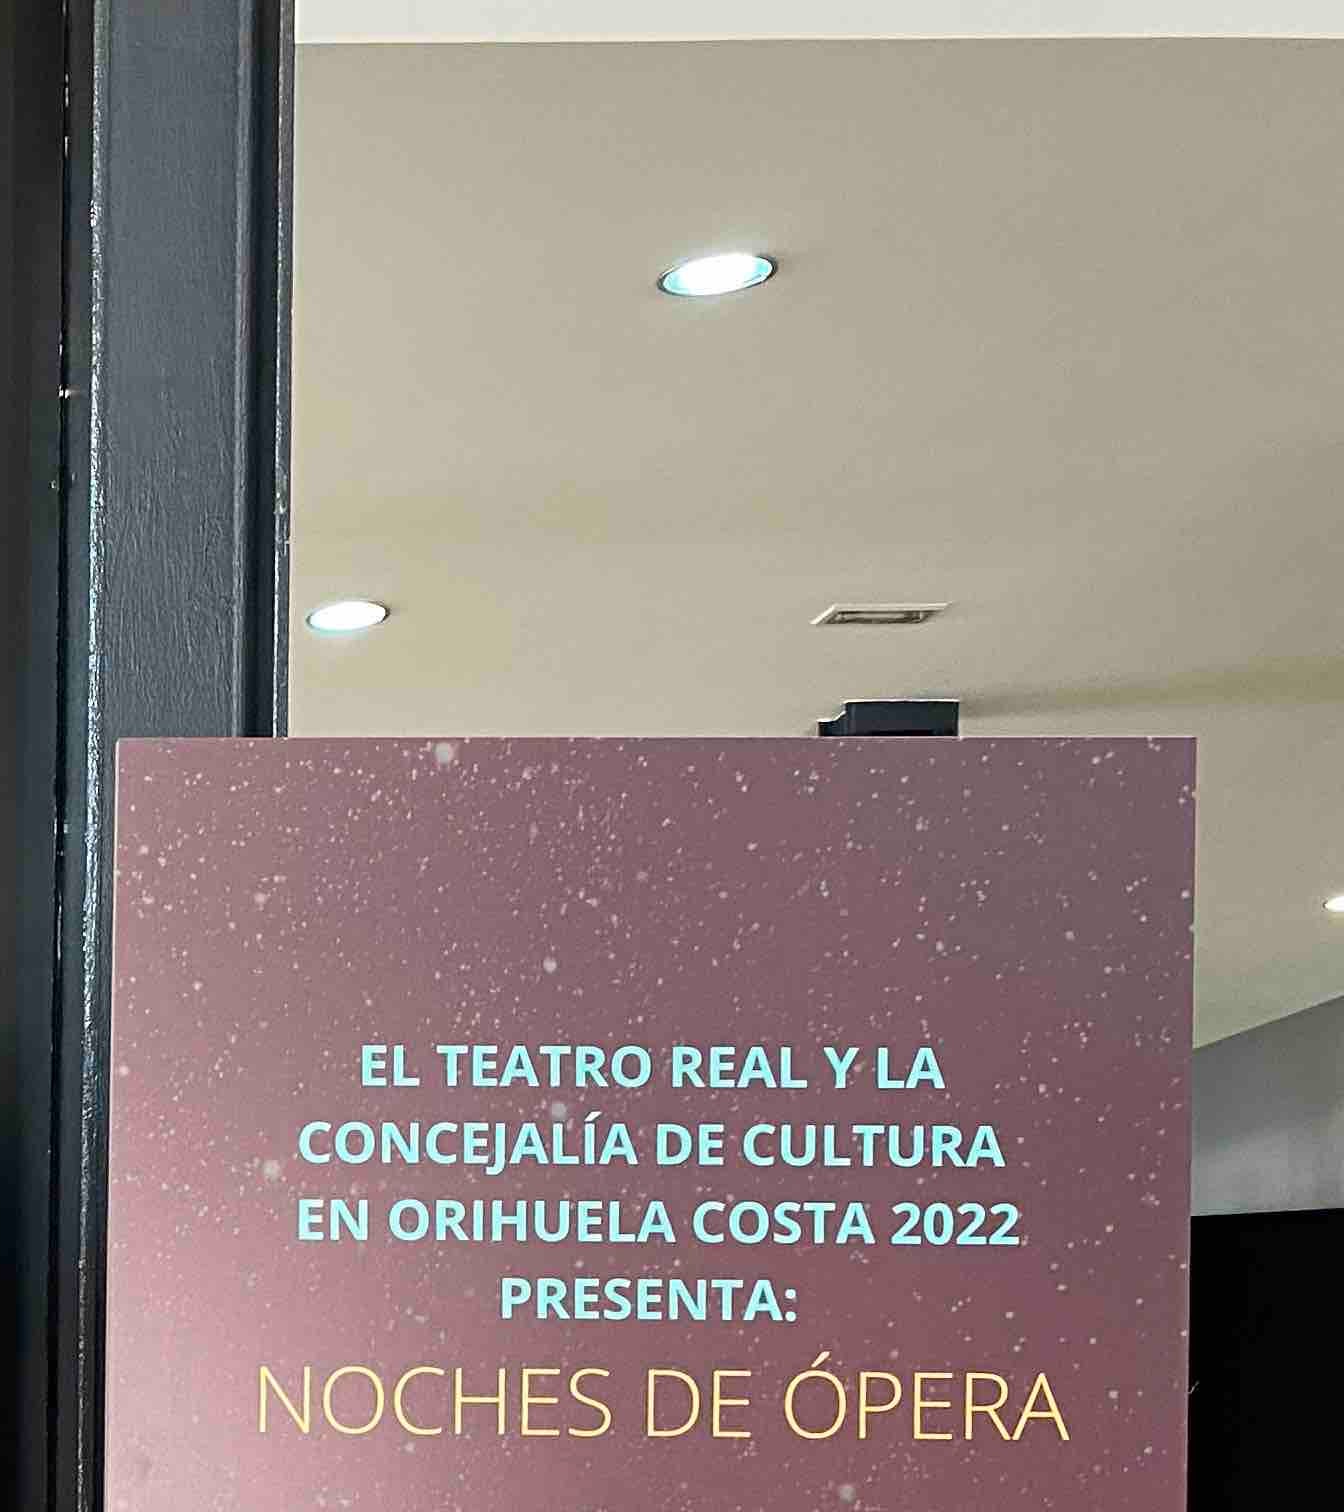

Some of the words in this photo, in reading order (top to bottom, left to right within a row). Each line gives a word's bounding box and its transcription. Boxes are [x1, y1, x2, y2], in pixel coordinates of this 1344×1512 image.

[360, 1044, 417, 1089] EL
[439, 1043, 653, 1089] TEATRO
[670, 1043, 807, 1090] REAL
[823, 1047, 857, 1090] Y
[875, 1046, 945, 1090] LA
[298, 1111, 637, 1176] CONCEJALÍA
[654, 1122, 722, 1168] DE
[742, 1122, 1006, 1169] CULTURA
[297, 1198, 370, 1242] EN
[387, 1198, 674, 1244] ORIHUELA
[692, 1199, 874, 1246] COSTA
[889, 1201, 1018, 1247] 2022
[500, 1277, 798, 1322] PRESENTA:
[255, 1363, 613, 1441] NOCHES
[643, 1366, 749, 1442] DE
[782, 1350, 1071, 1442] ÓPERA
